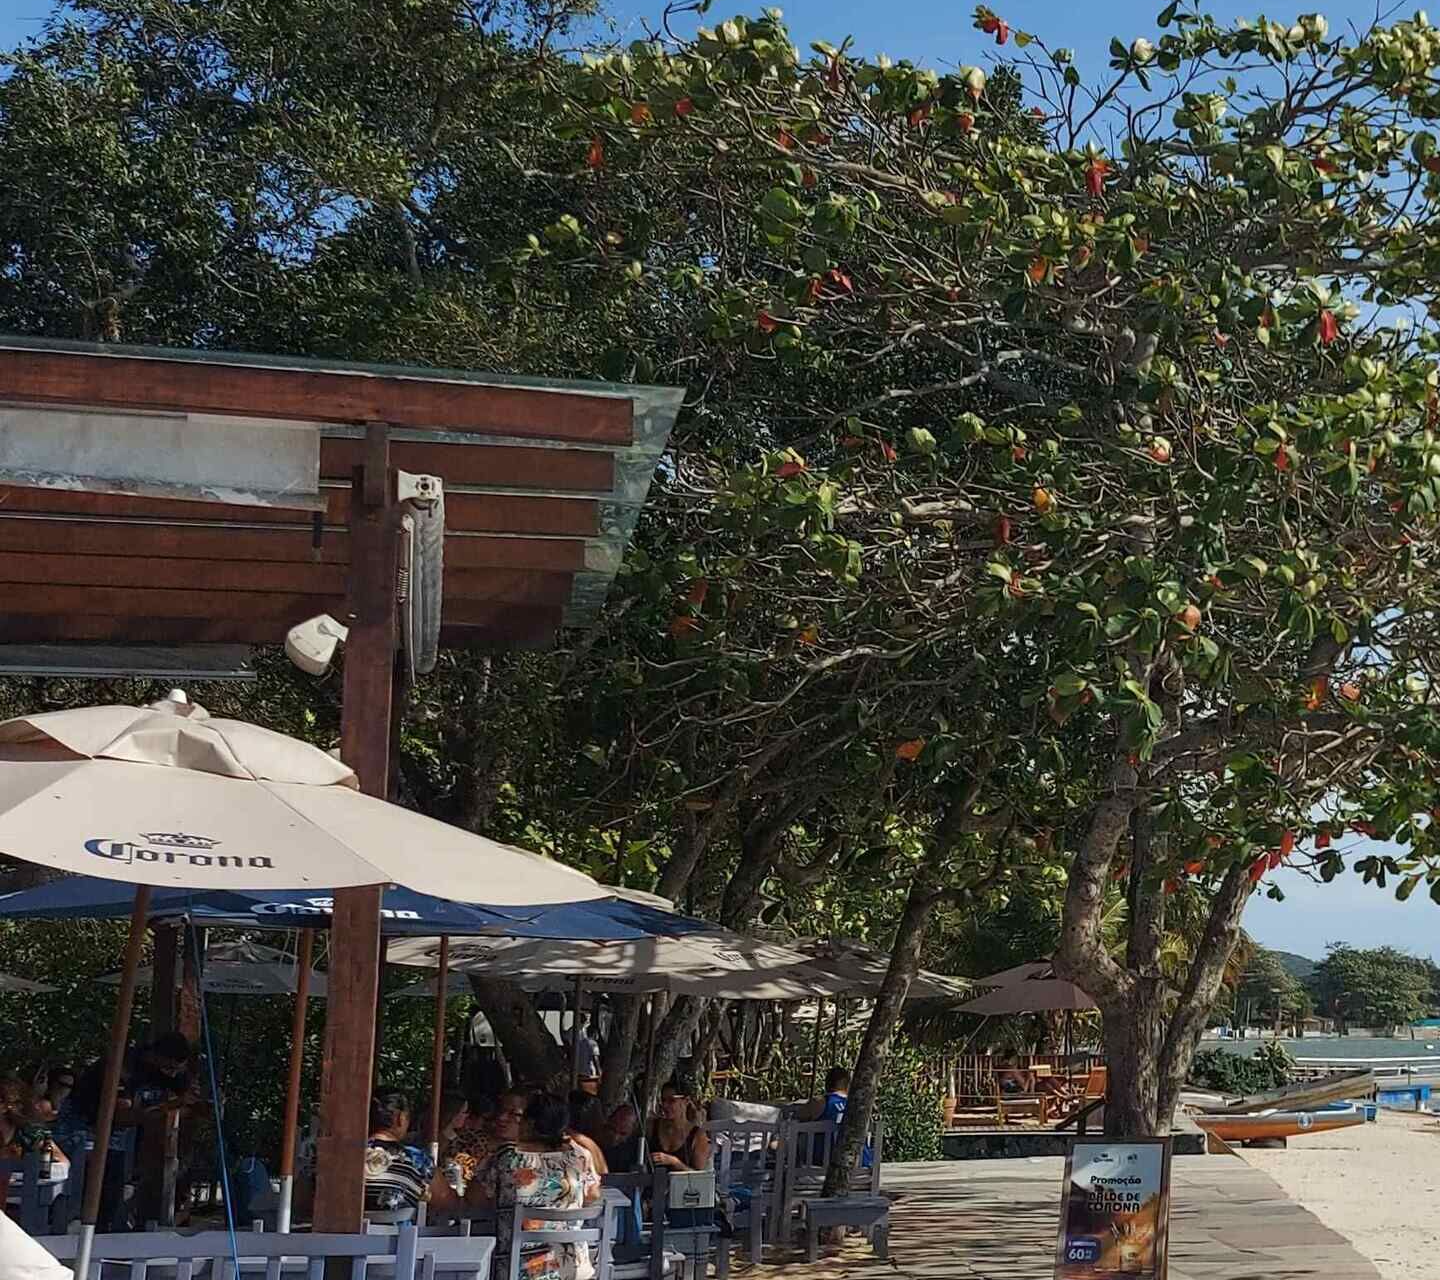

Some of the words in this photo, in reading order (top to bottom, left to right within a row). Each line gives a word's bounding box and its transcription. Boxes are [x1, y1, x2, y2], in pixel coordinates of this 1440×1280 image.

[84, 838, 276, 868] Corona
[1090, 1175, 1142, 1186] Promoção
[1069, 1248, 1084, 1260] 60
